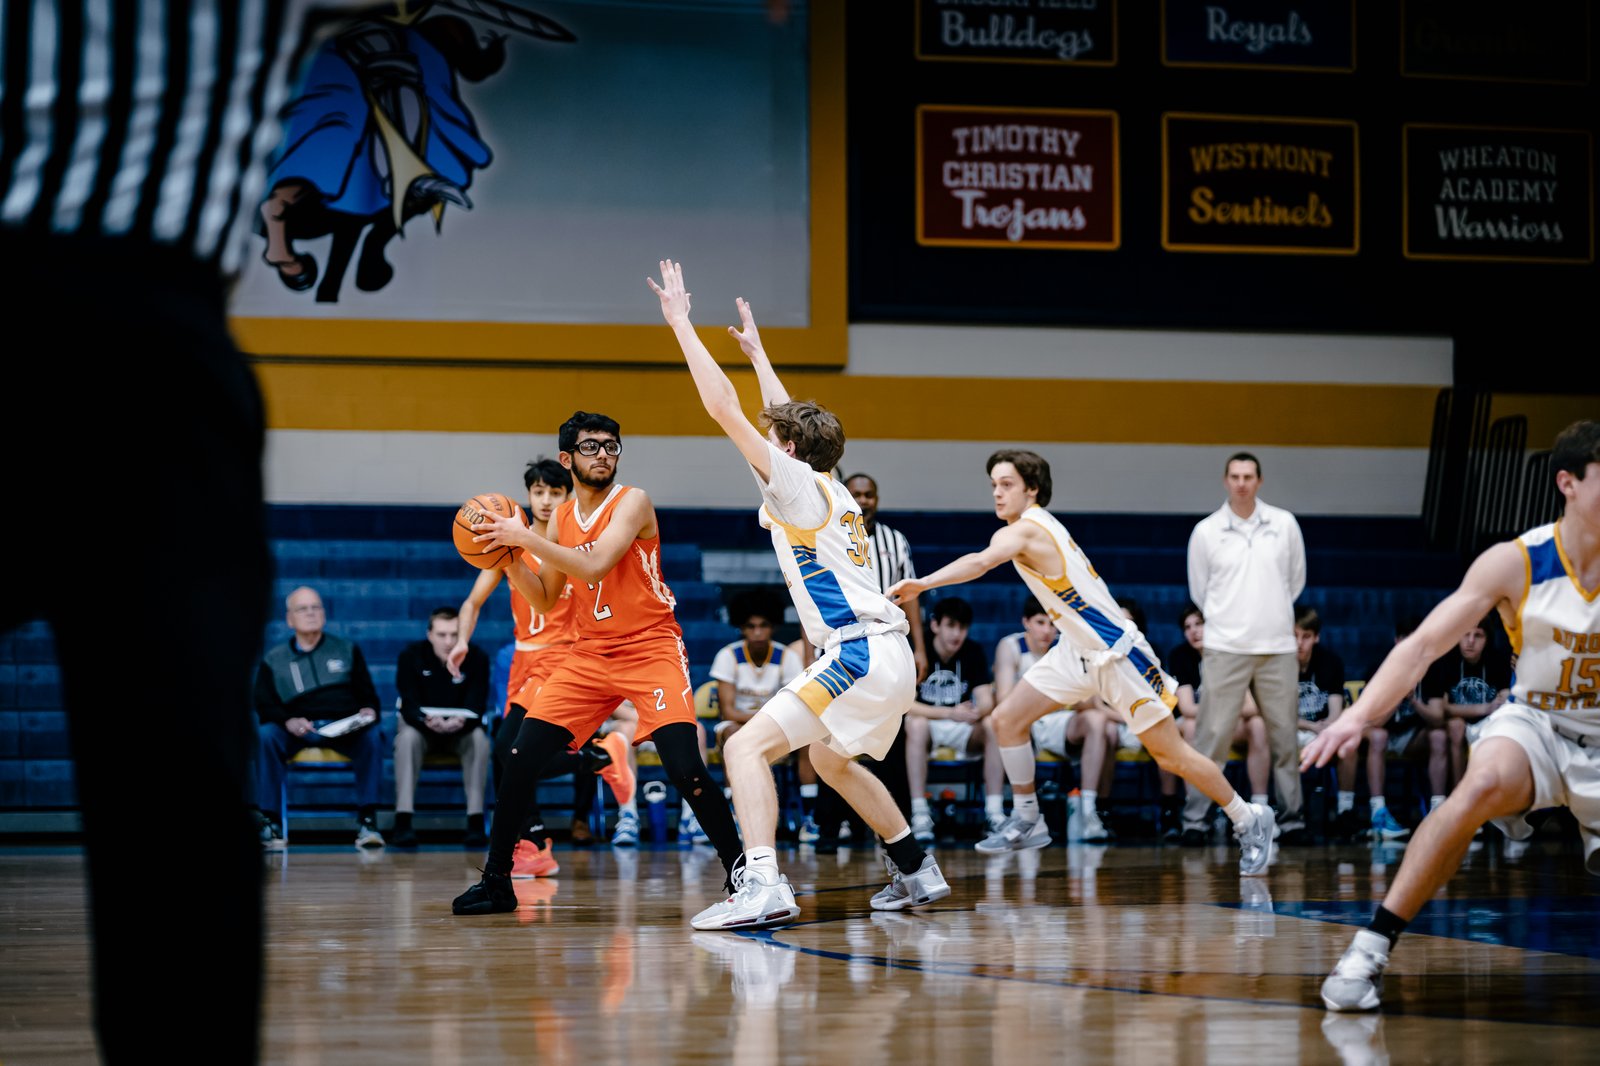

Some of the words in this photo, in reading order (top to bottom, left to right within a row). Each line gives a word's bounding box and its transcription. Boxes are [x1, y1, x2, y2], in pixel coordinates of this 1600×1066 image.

[940, 9, 1093, 61] Bulldogs
[1205, 5, 1313, 54] Royals
[951, 123, 1082, 158] TIMOTHY
[942, 160, 1094, 193] CHRISTIAN
[1189, 142, 1334, 179] WESTMONT
[1438, 144, 1558, 177] WHEATON
[1187, 185, 1334, 229] Sentinels
[1438, 176, 1558, 204] ACADEMY
[950, 189, 1087, 243] Trojans
[1434, 203, 1564, 243] Warriors
[1556, 657, 1600, 693] 15
[653, 688, 667, 711] 2
[1527, 690, 1600, 711] CENTR
